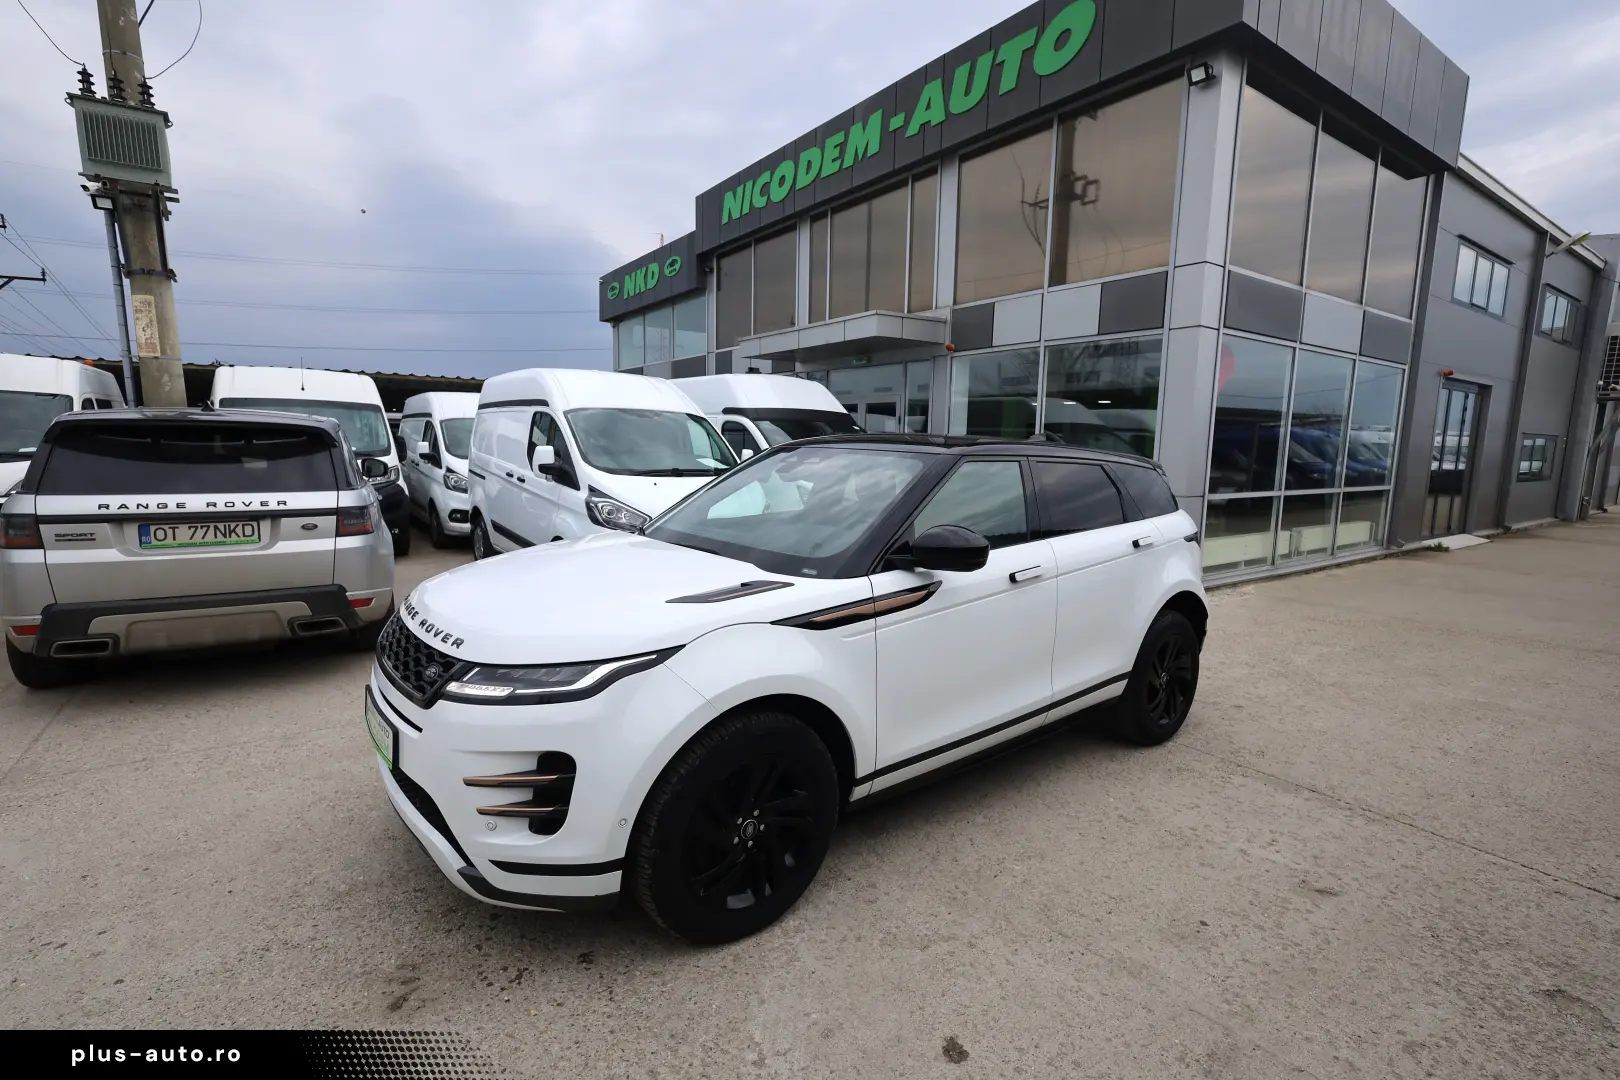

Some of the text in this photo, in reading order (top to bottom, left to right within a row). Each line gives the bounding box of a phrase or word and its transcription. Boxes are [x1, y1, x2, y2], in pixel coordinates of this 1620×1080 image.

[624, 263, 659, 300] NKD
[97, 500, 288, 511] RANGE ROVER
[153, 526, 179, 542] OT
[418, 618, 465, 649] ROVER
